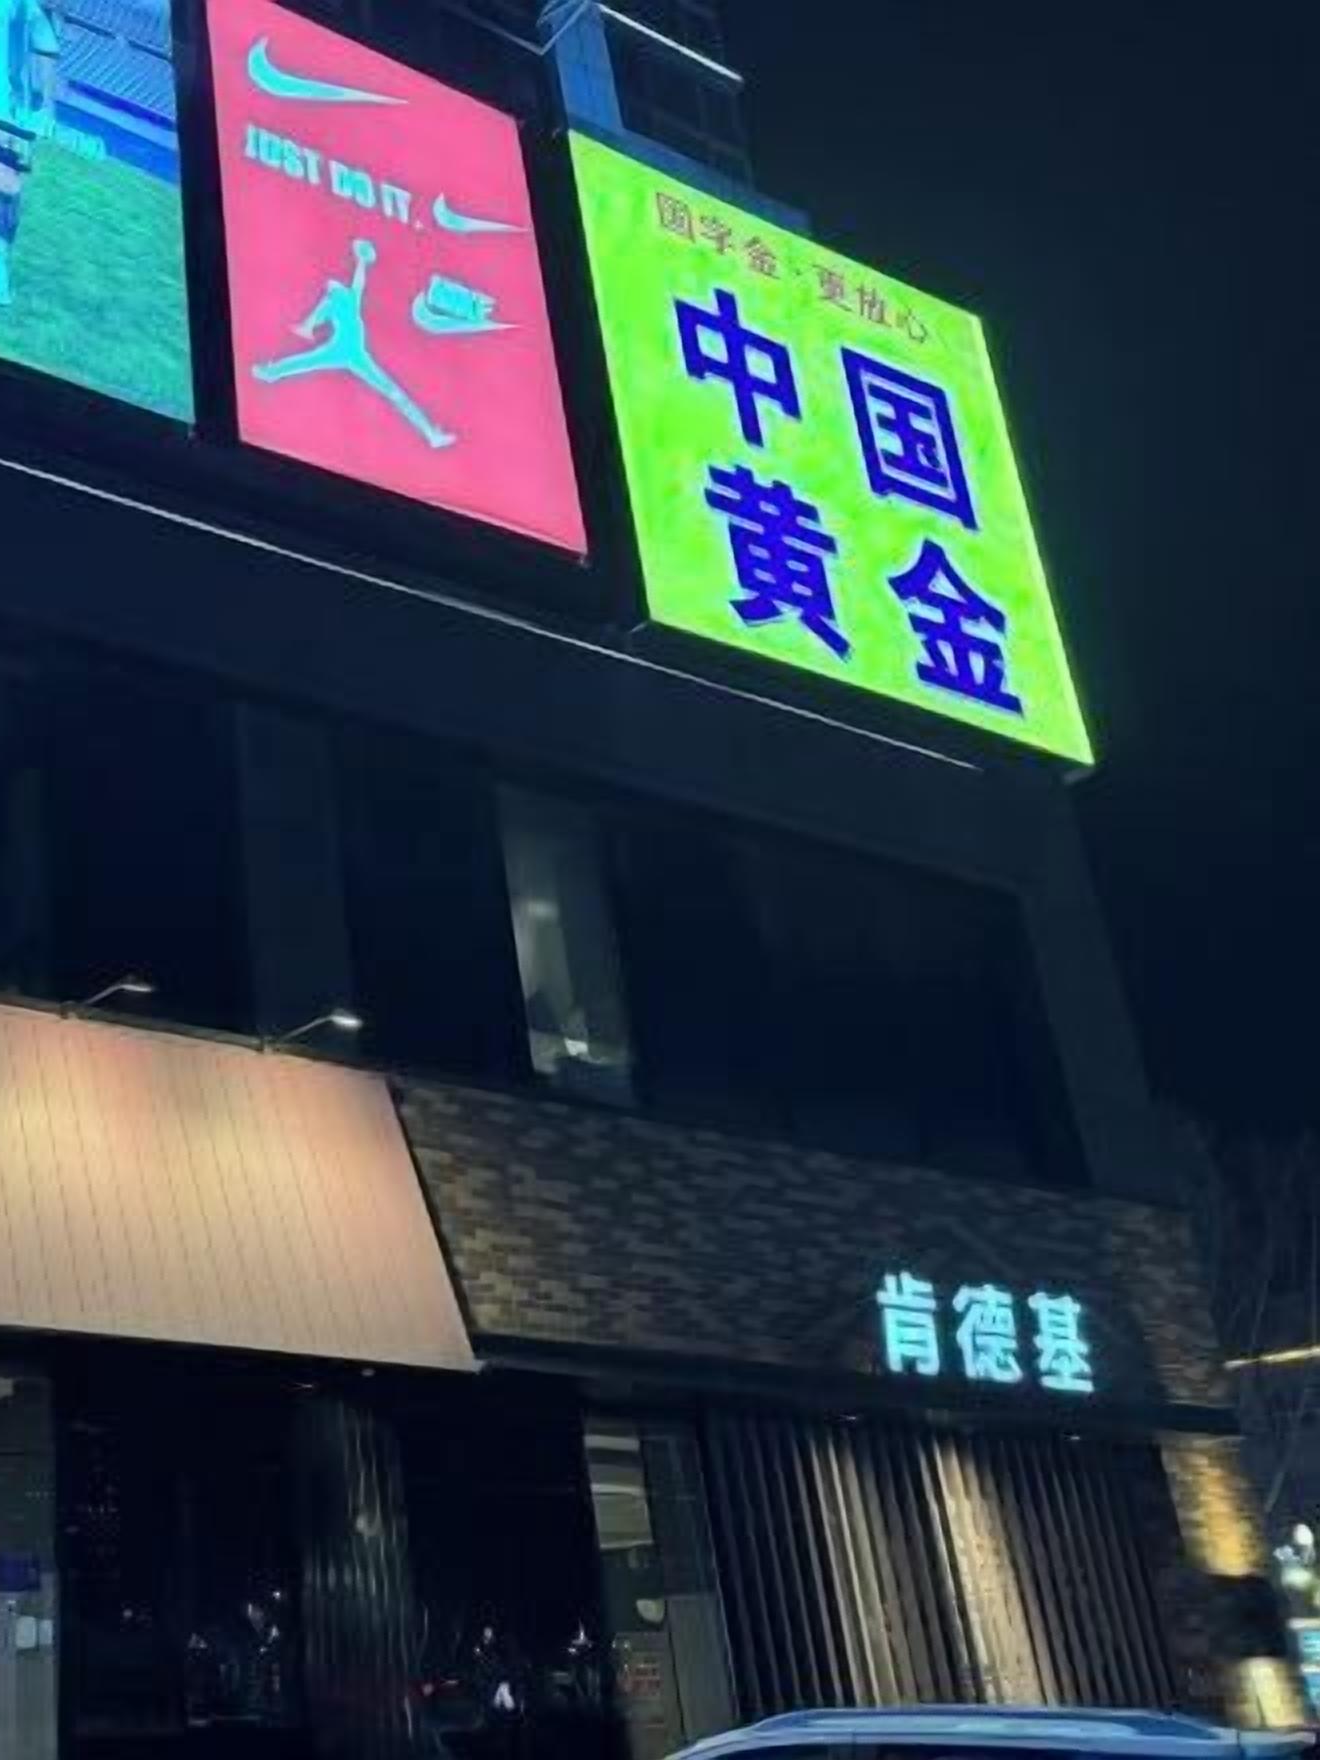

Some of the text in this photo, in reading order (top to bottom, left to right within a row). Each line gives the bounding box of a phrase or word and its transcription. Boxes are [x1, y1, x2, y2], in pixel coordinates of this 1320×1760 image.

[244, 122, 321, 185] JUST
[329, 160, 377, 209] DO
[673, 288, 980, 532] 中国
[704, 464, 1025, 718] 黄金
[876, 1271, 1095, 1394] 肯德基
